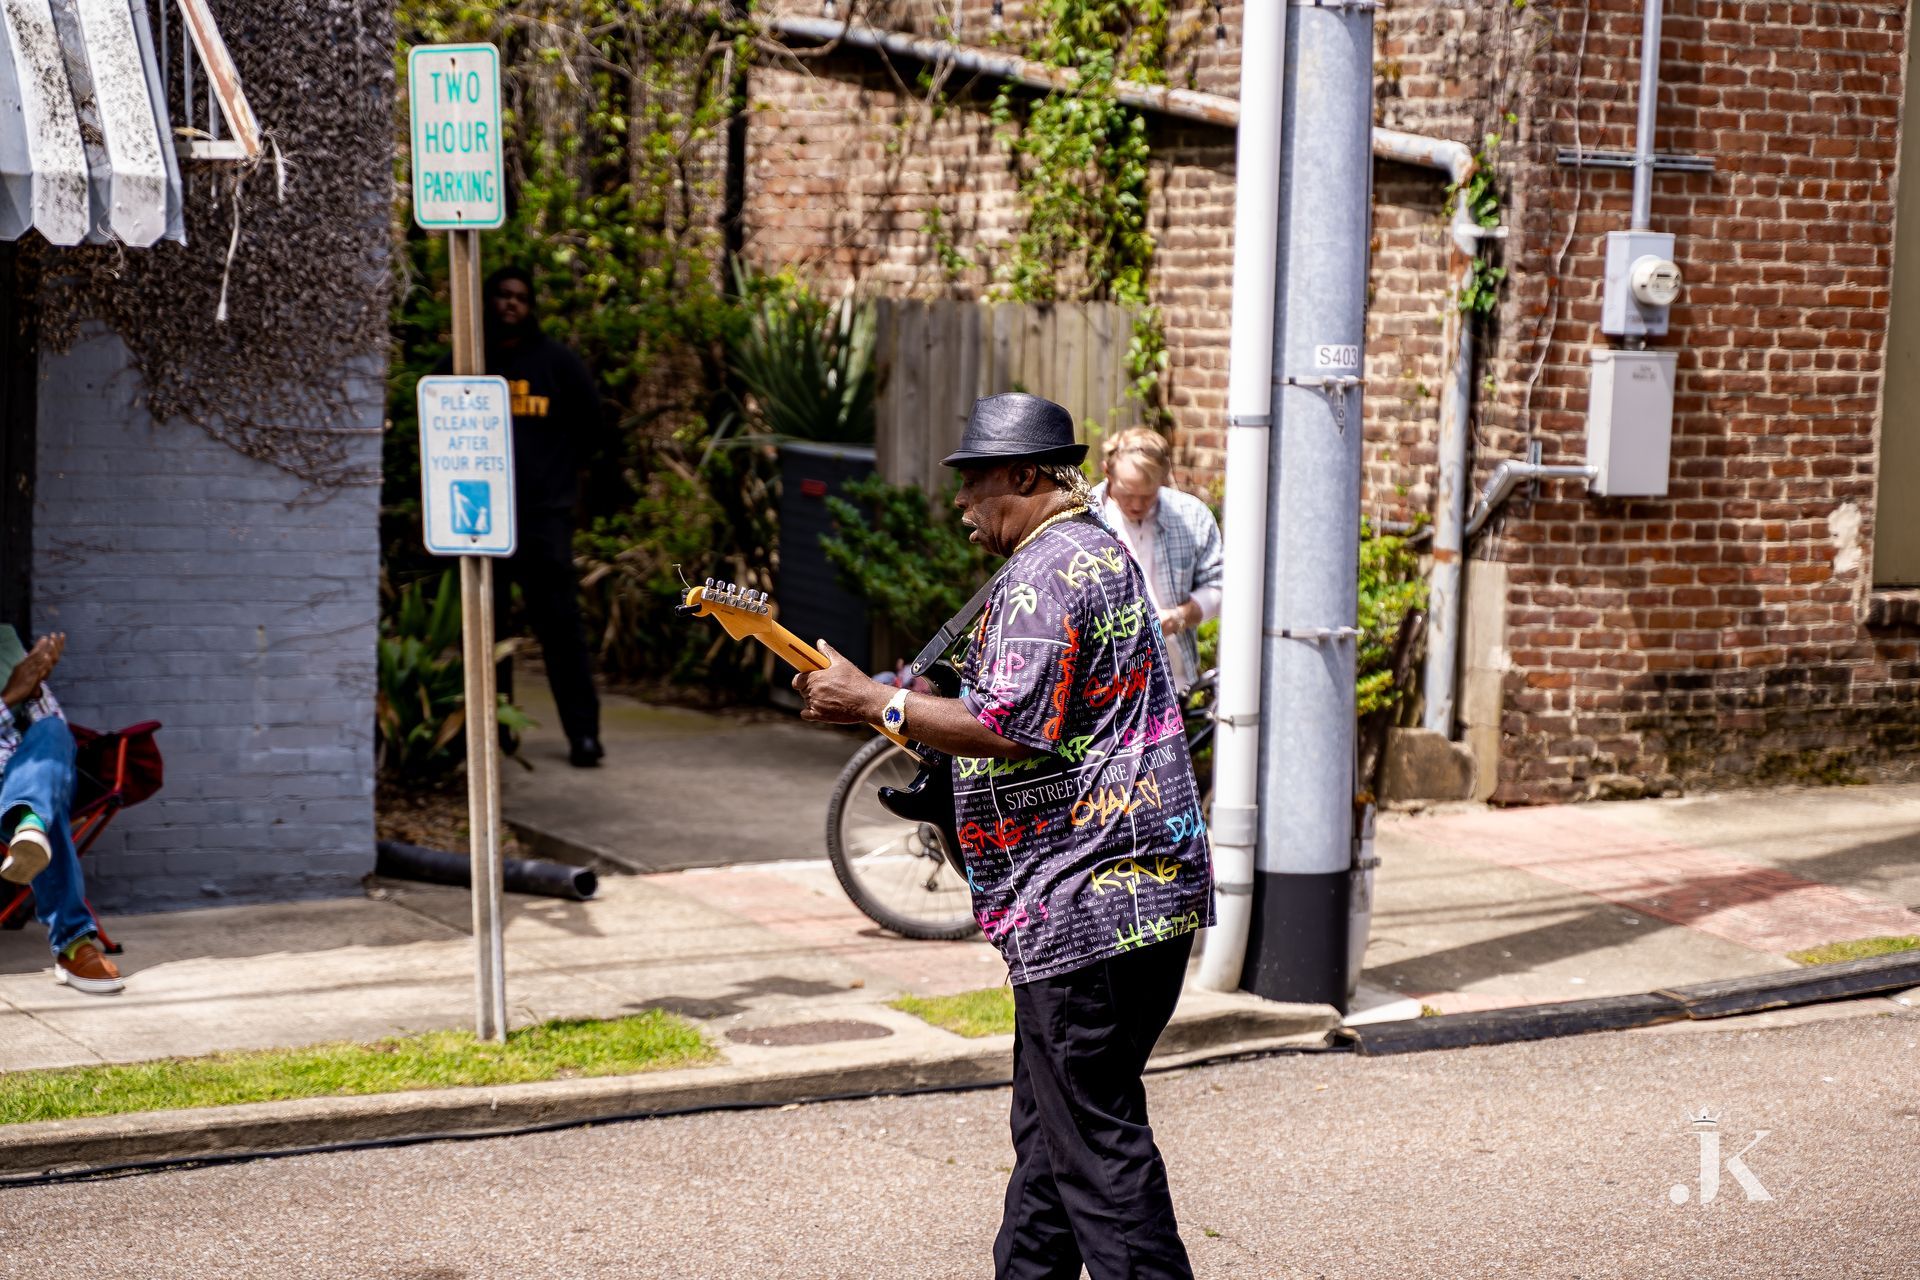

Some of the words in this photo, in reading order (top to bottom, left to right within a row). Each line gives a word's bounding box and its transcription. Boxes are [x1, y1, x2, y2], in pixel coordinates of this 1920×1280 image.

[431, 71, 480, 103] TWO
[424, 121, 489, 153] HOUR
[423, 170, 494, 203] PARKING
[1319, 347, 1358, 366] S403
[440, 395, 491, 411] PLEASE
[448, 435, 489, 450] AFTER
[431, 456, 470, 471] YOUR
[474, 456, 505, 472] PETS
[1101, 763, 1130, 786] ARE
